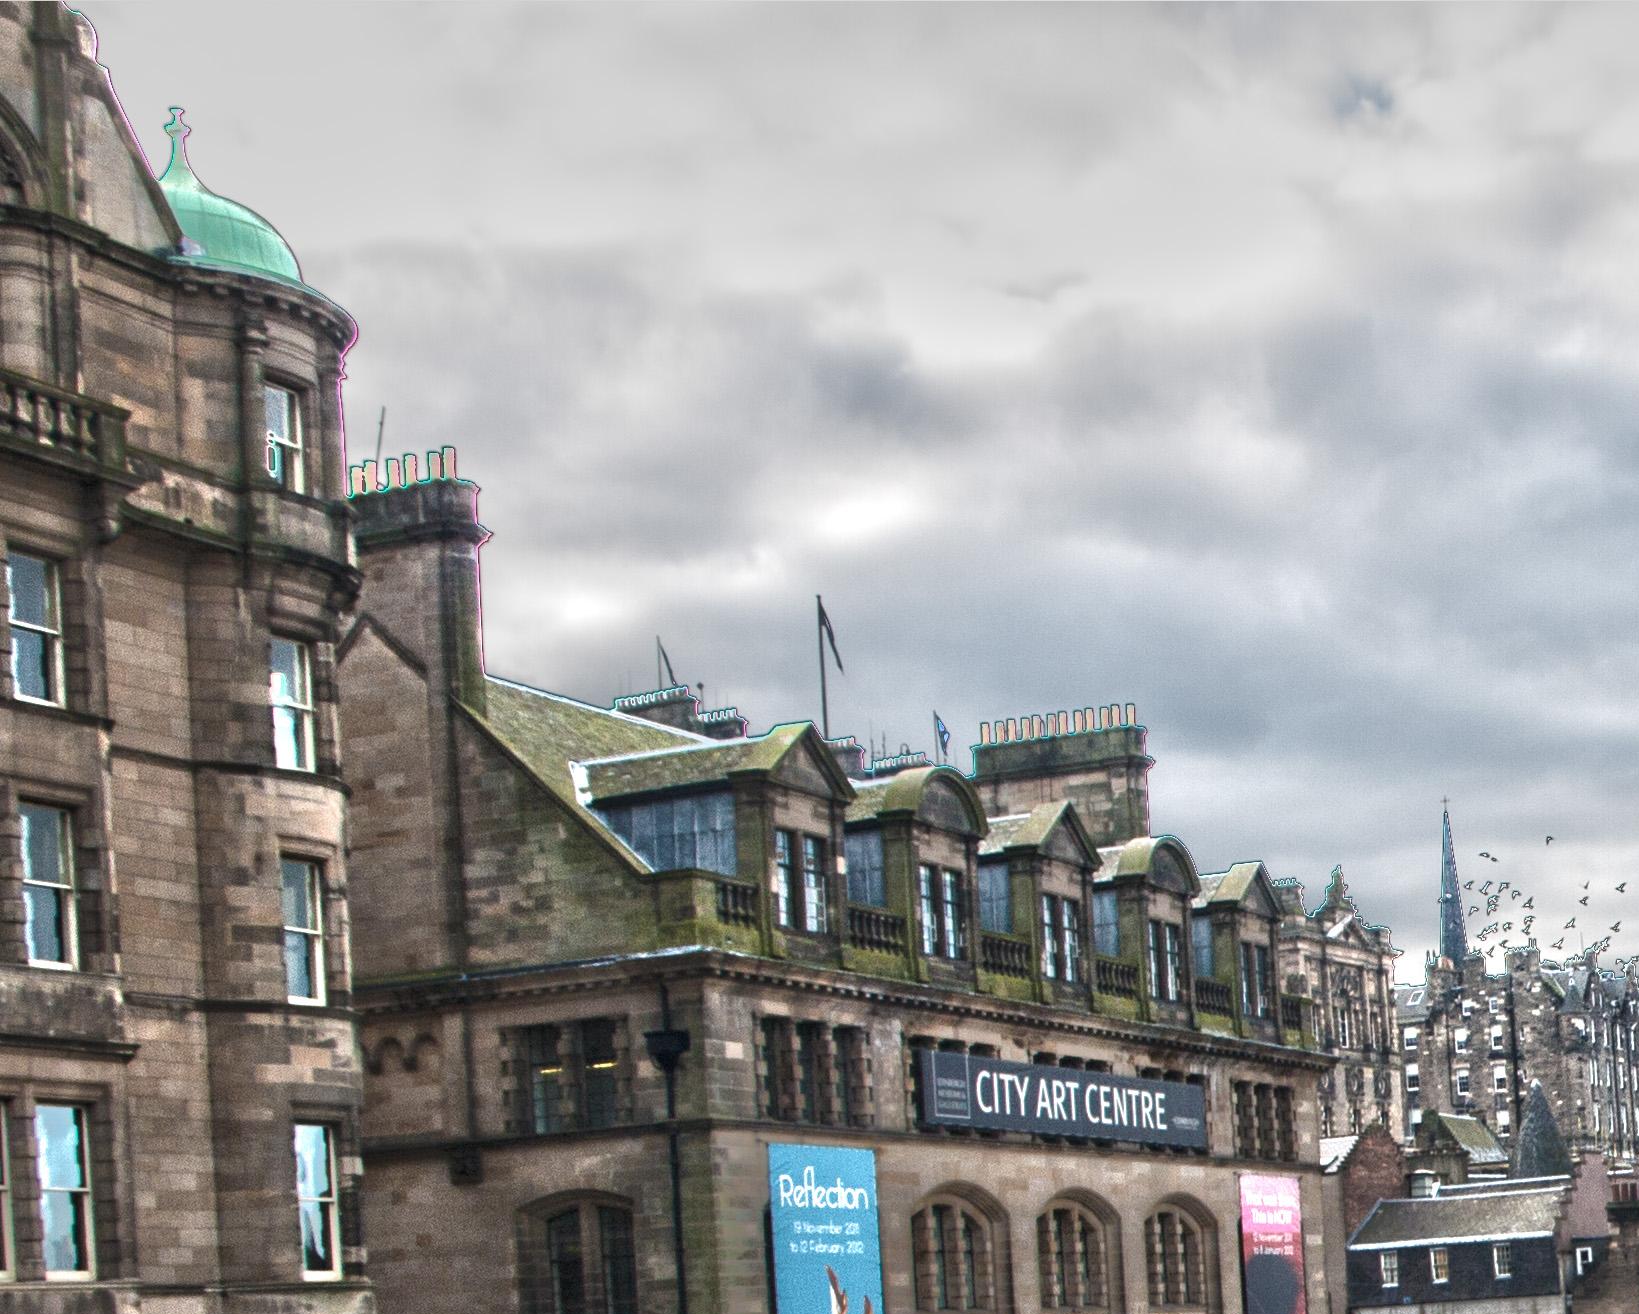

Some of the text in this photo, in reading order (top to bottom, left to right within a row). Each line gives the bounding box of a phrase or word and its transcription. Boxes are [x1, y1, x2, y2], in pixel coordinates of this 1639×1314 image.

[976, 1070, 1168, 1130] CITY ART CENTRE
[778, 1165, 869, 1209] Reflection
[803, 1219, 842, 1236] November
[809, 1237, 845, 1255] February
